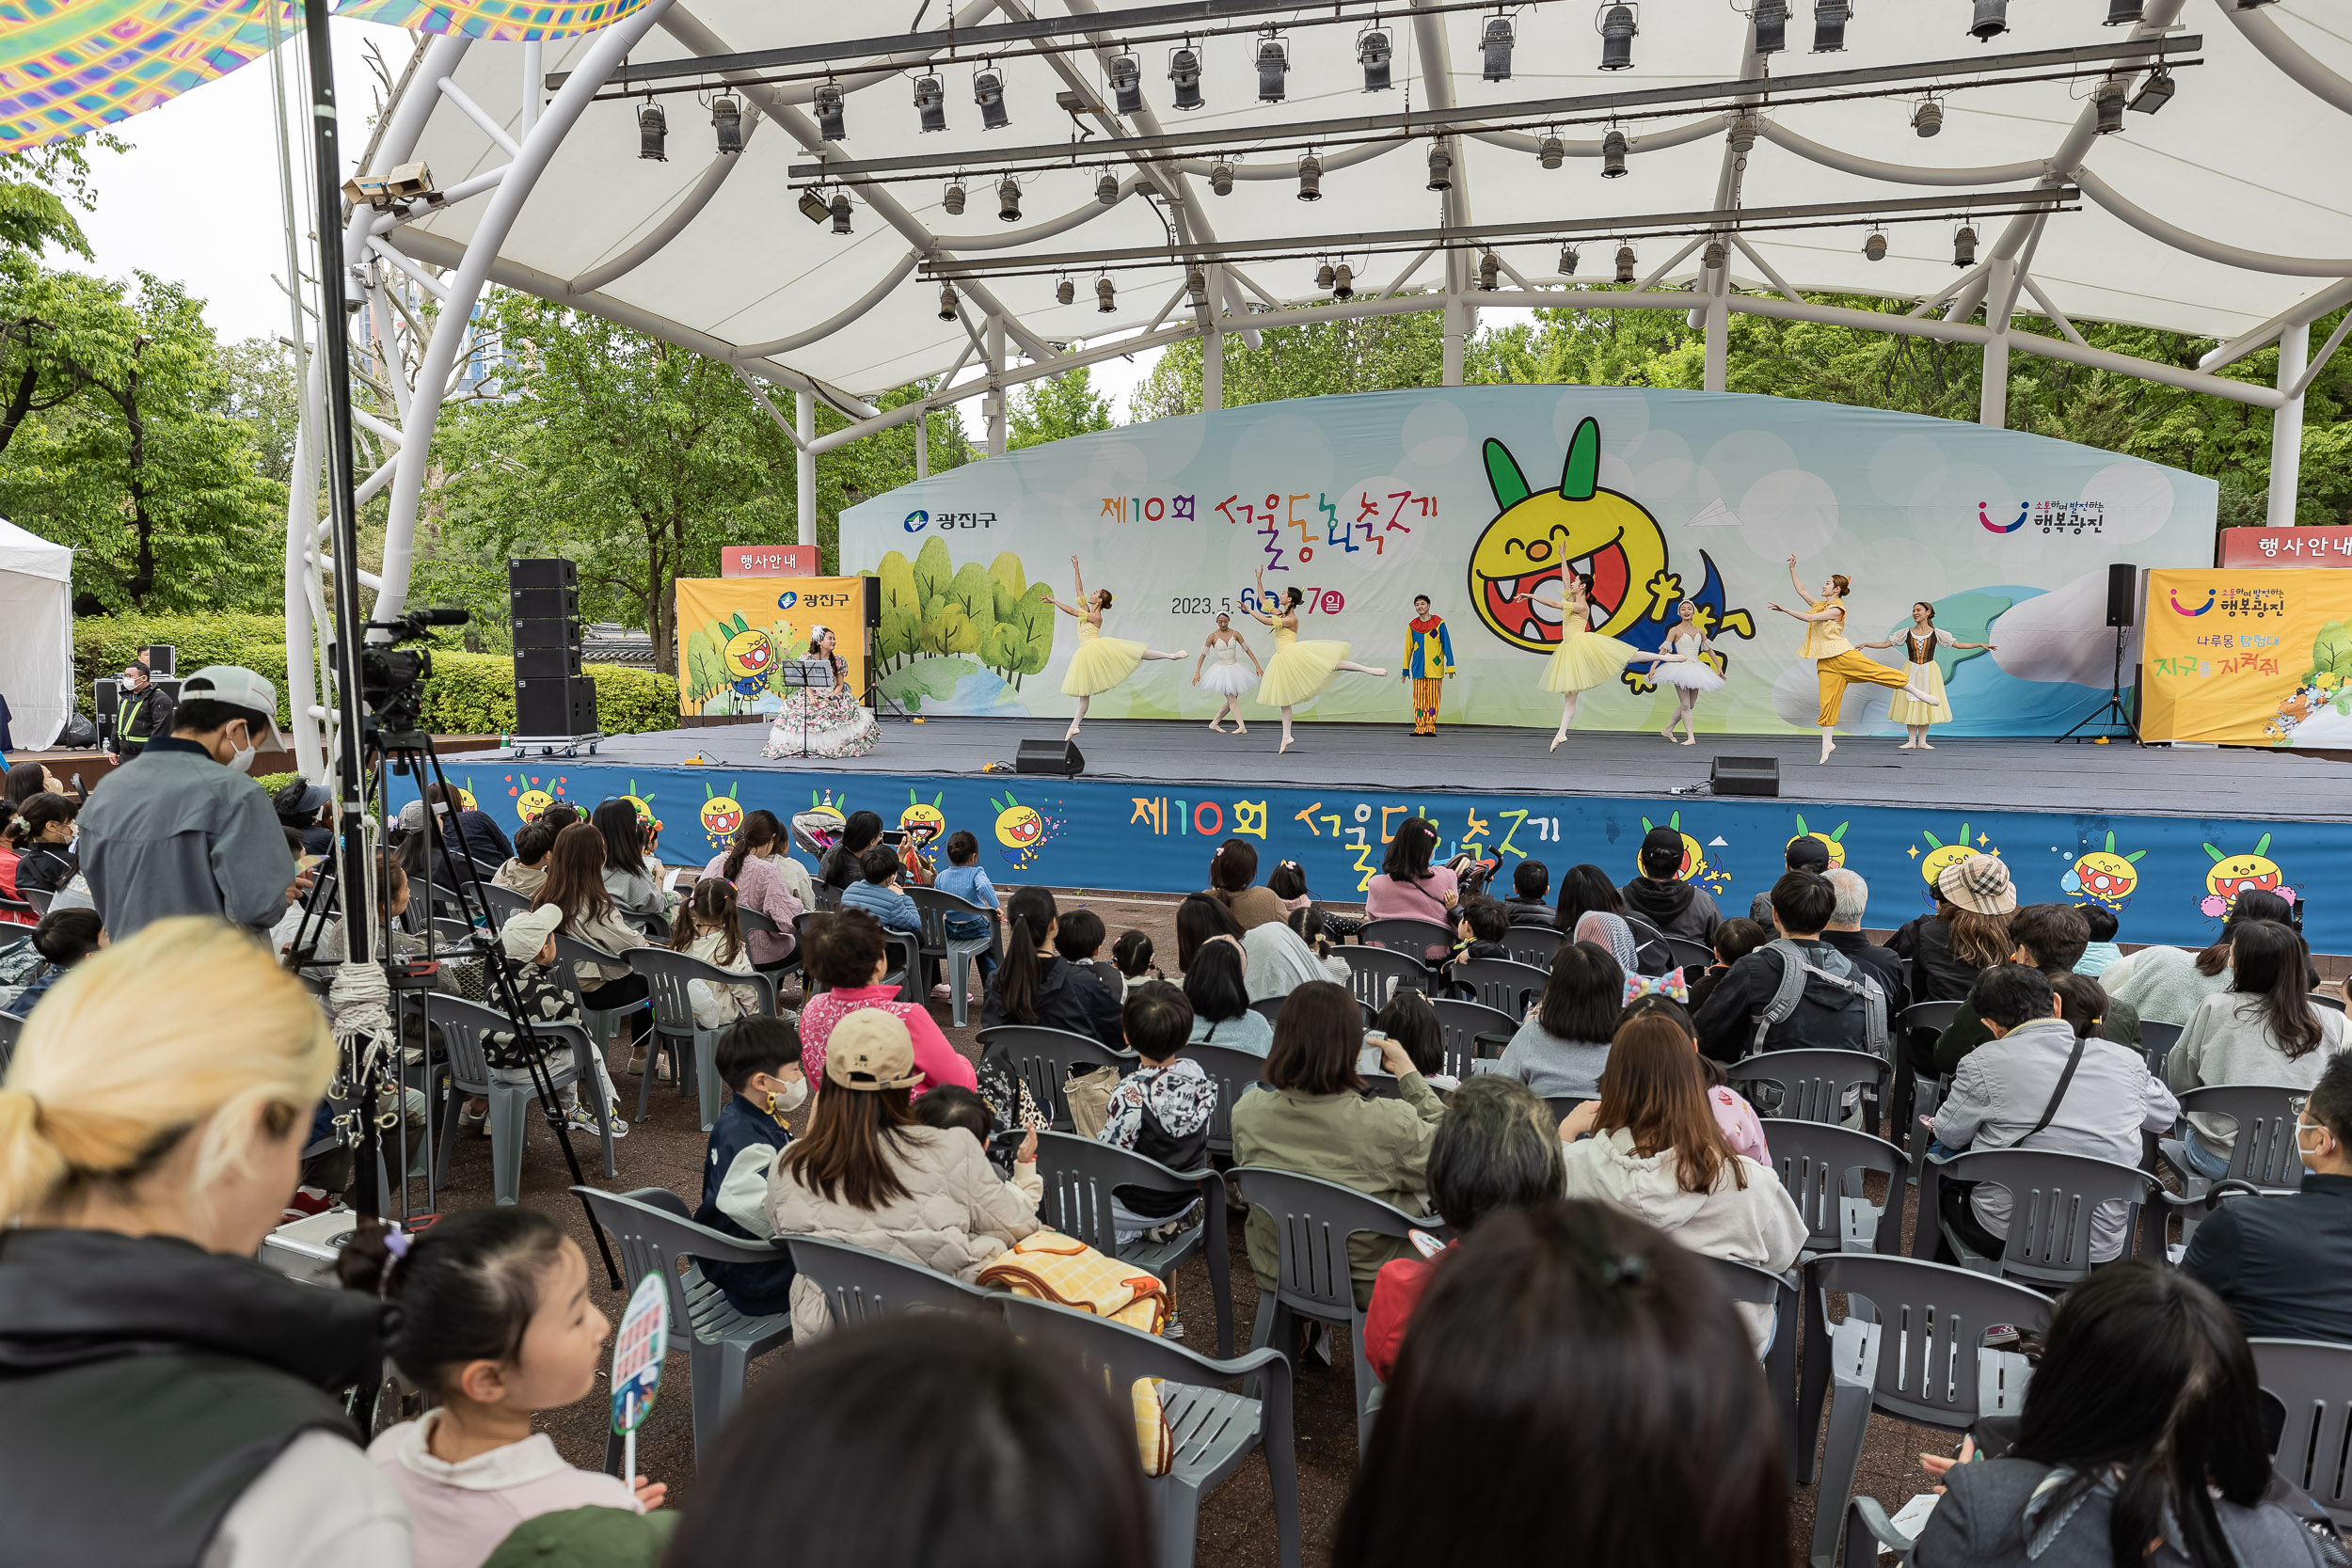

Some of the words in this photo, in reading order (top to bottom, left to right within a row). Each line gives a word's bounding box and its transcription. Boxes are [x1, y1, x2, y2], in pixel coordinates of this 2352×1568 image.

[1100, 495, 1196, 524] 제10회
[2034, 500, 2068, 513] 소통하며
[2070, 500, 2104, 514] 발전하는
[936, 513, 997, 530] 광진구
[2033, 513, 2104, 534] 행복광진
[2258, 537, 2352, 558] 행사안내
[739, 553, 797, 570] 행사안내
[803, 594, 850, 608] 광진구
[2221, 588, 2251, 599] 소통하며
[2253, 588, 2284, 599] 발전하는
[1171, 597, 1216, 614] 2023.
[2220, 599, 2284, 617] 행복광진
[2197, 634, 2233, 648] 나루몽
[2240, 634, 2280, 648] 탐험대
[2153, 656, 2212, 677] 지구를
[2217, 652, 2280, 676] 지켜줘
[1130, 797, 1266, 840] 제10회
